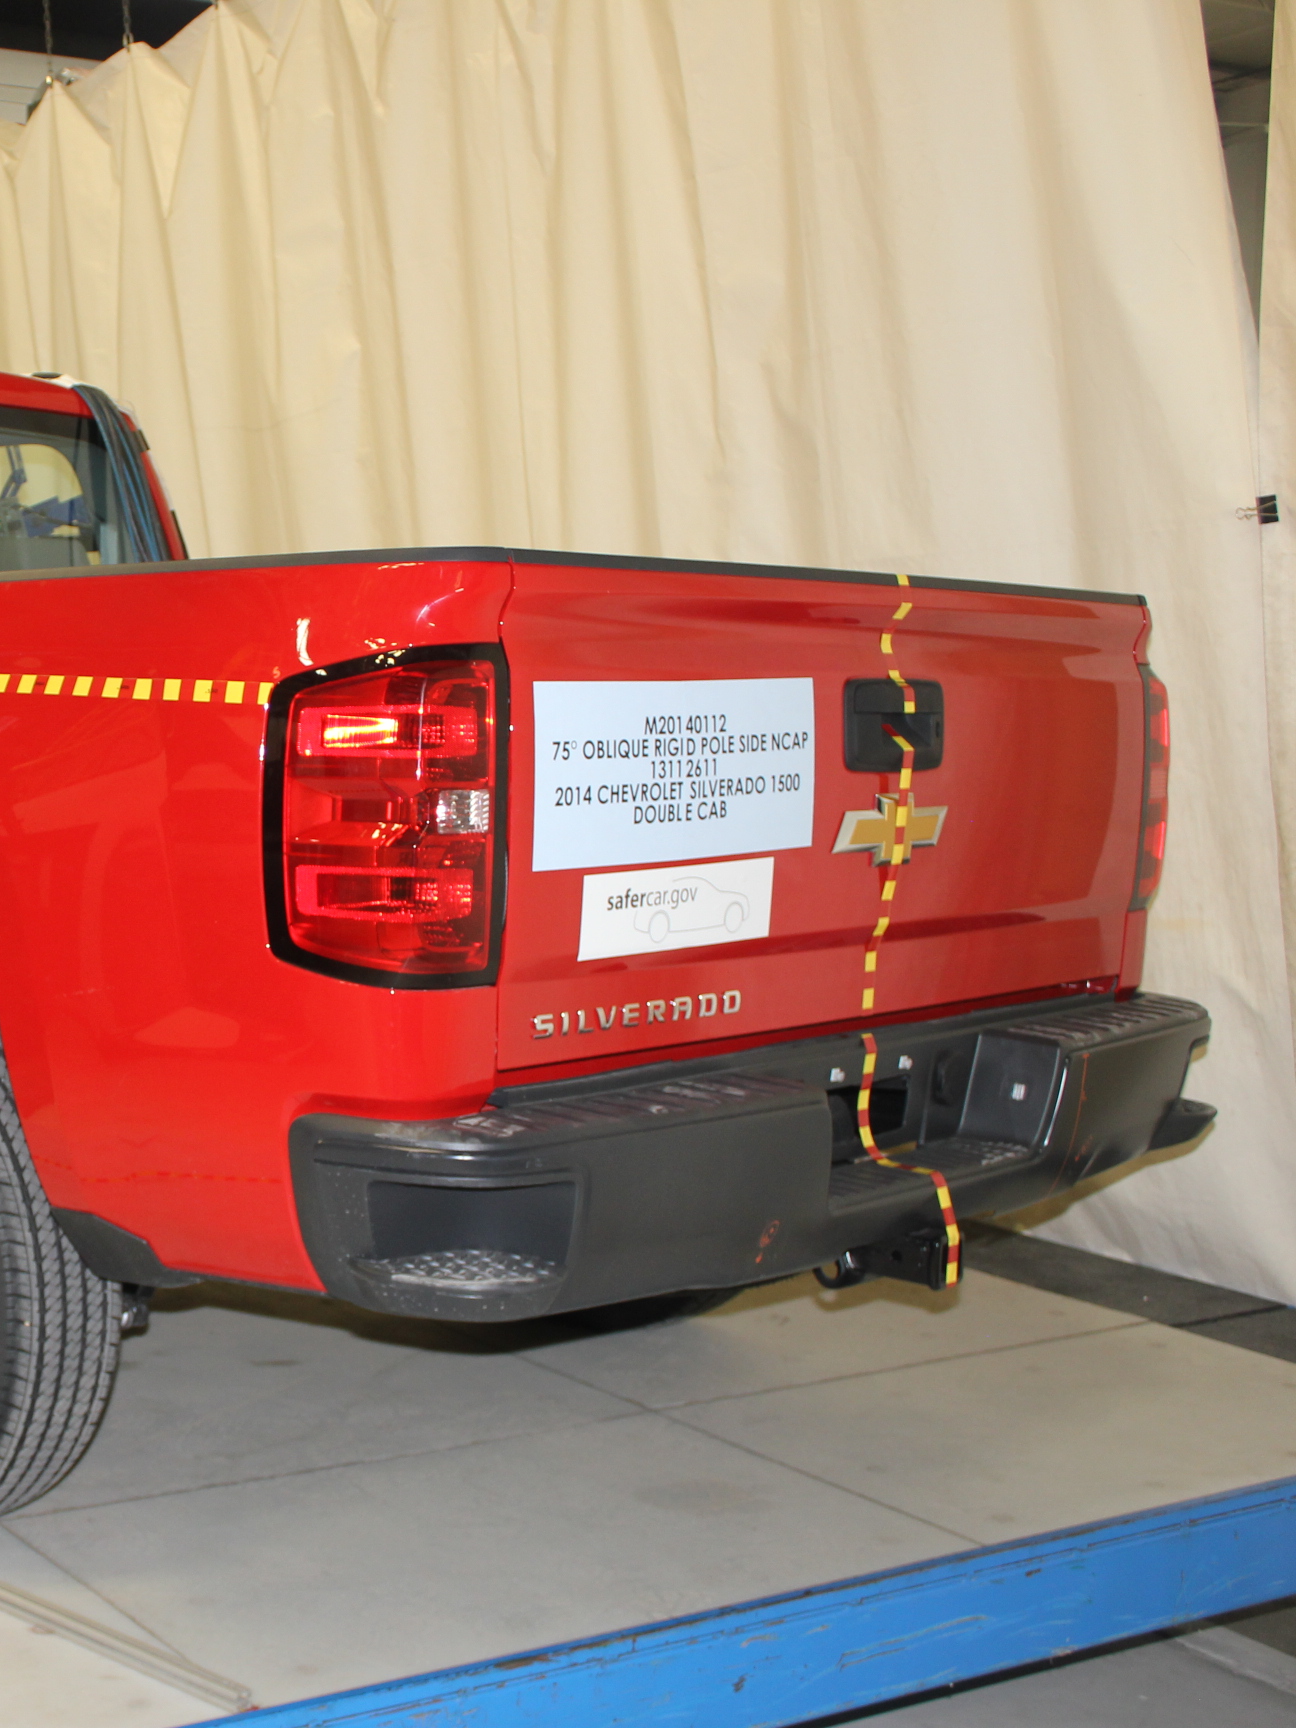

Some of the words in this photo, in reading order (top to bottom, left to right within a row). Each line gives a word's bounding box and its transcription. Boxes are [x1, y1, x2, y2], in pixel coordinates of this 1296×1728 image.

[644, 714, 727, 735] M20140112
[582, 739, 649, 760] OBLIQUE
[654, 737, 696, 757] RIGID
[701, 735, 735, 755] POLE
[739, 733, 767, 753] SIDE
[771, 731, 808, 751] NCAP
[651, 758, 717, 779] 13112611
[555, 785, 592, 807] 2014
[597, 781, 683, 804] CHEVROLET
[690, 776, 766, 799] SILVERADO
[771, 773, 800, 793] 1500
[634, 803, 692, 824] DOUBLE
[697, 800, 727, 820] CAB
[607, 887, 698, 911] safercar.gov
[533, 990, 742, 1039] SILVERADO
